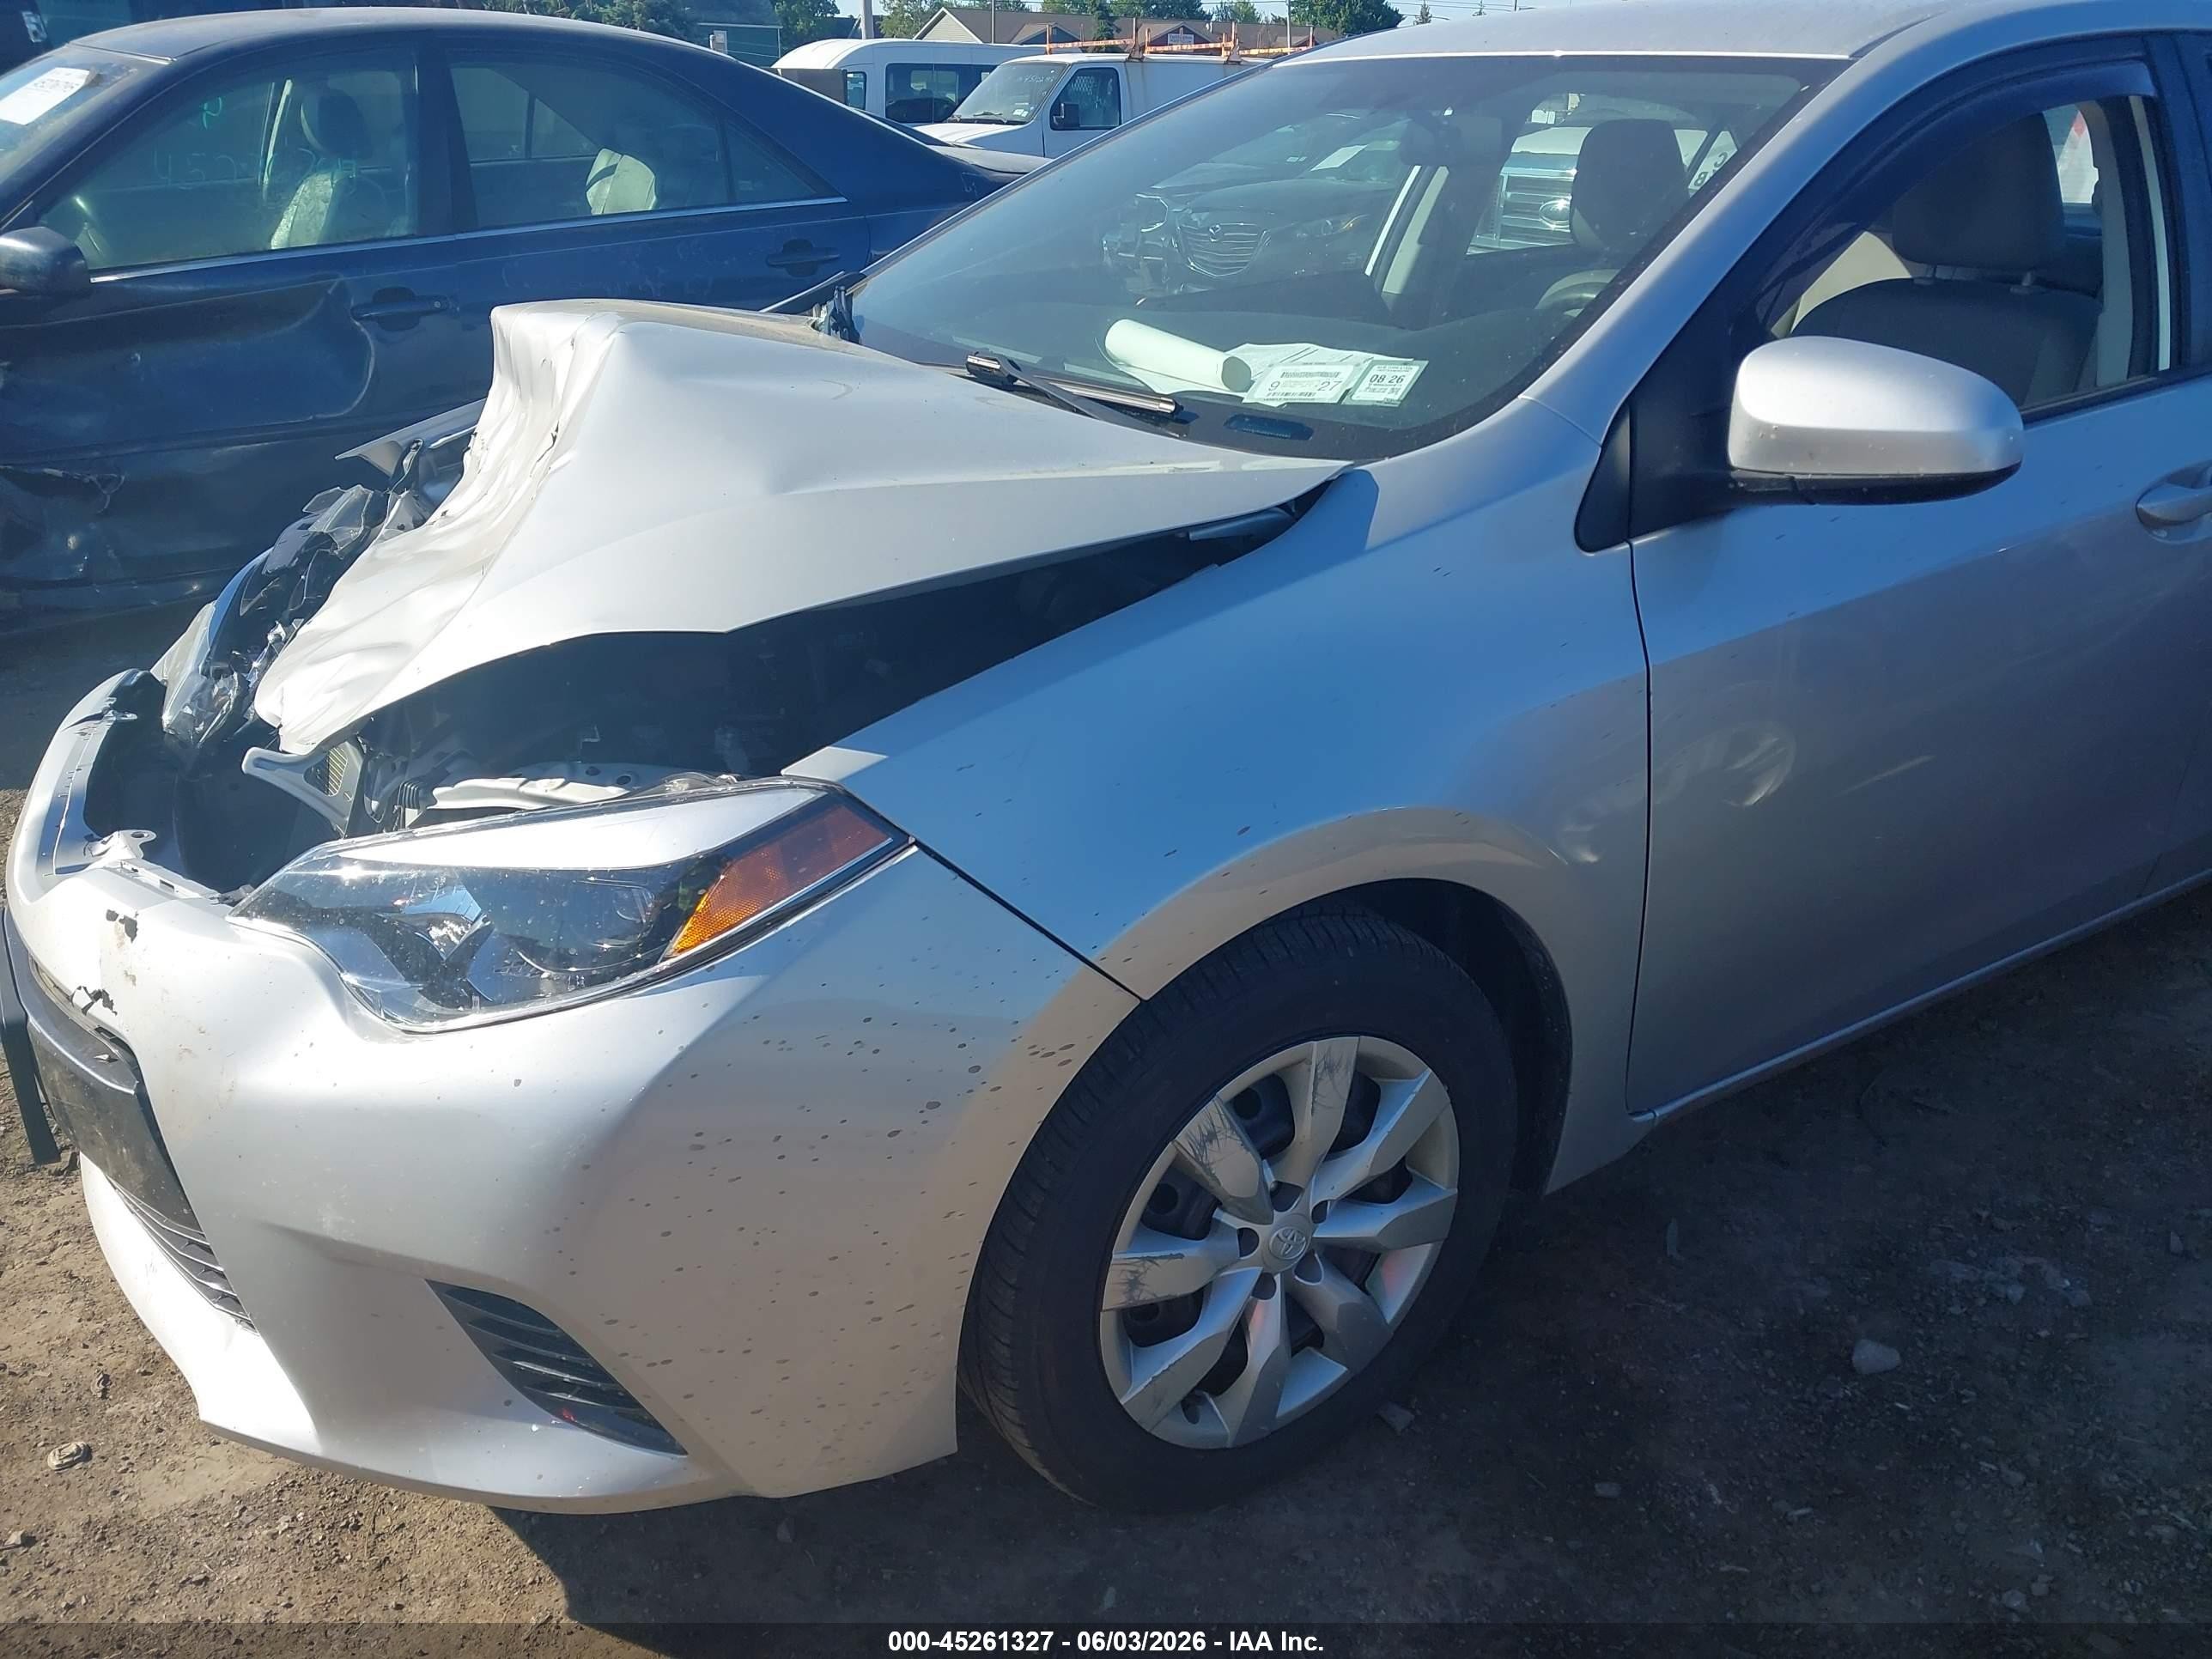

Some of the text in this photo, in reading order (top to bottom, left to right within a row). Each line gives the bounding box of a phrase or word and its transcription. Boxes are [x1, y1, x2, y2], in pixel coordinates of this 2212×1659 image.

[1370, 374, 1406, 384] 08 26
[1268, 380, 1280, 392] 9
[1317, 380, 1342, 392] 27
